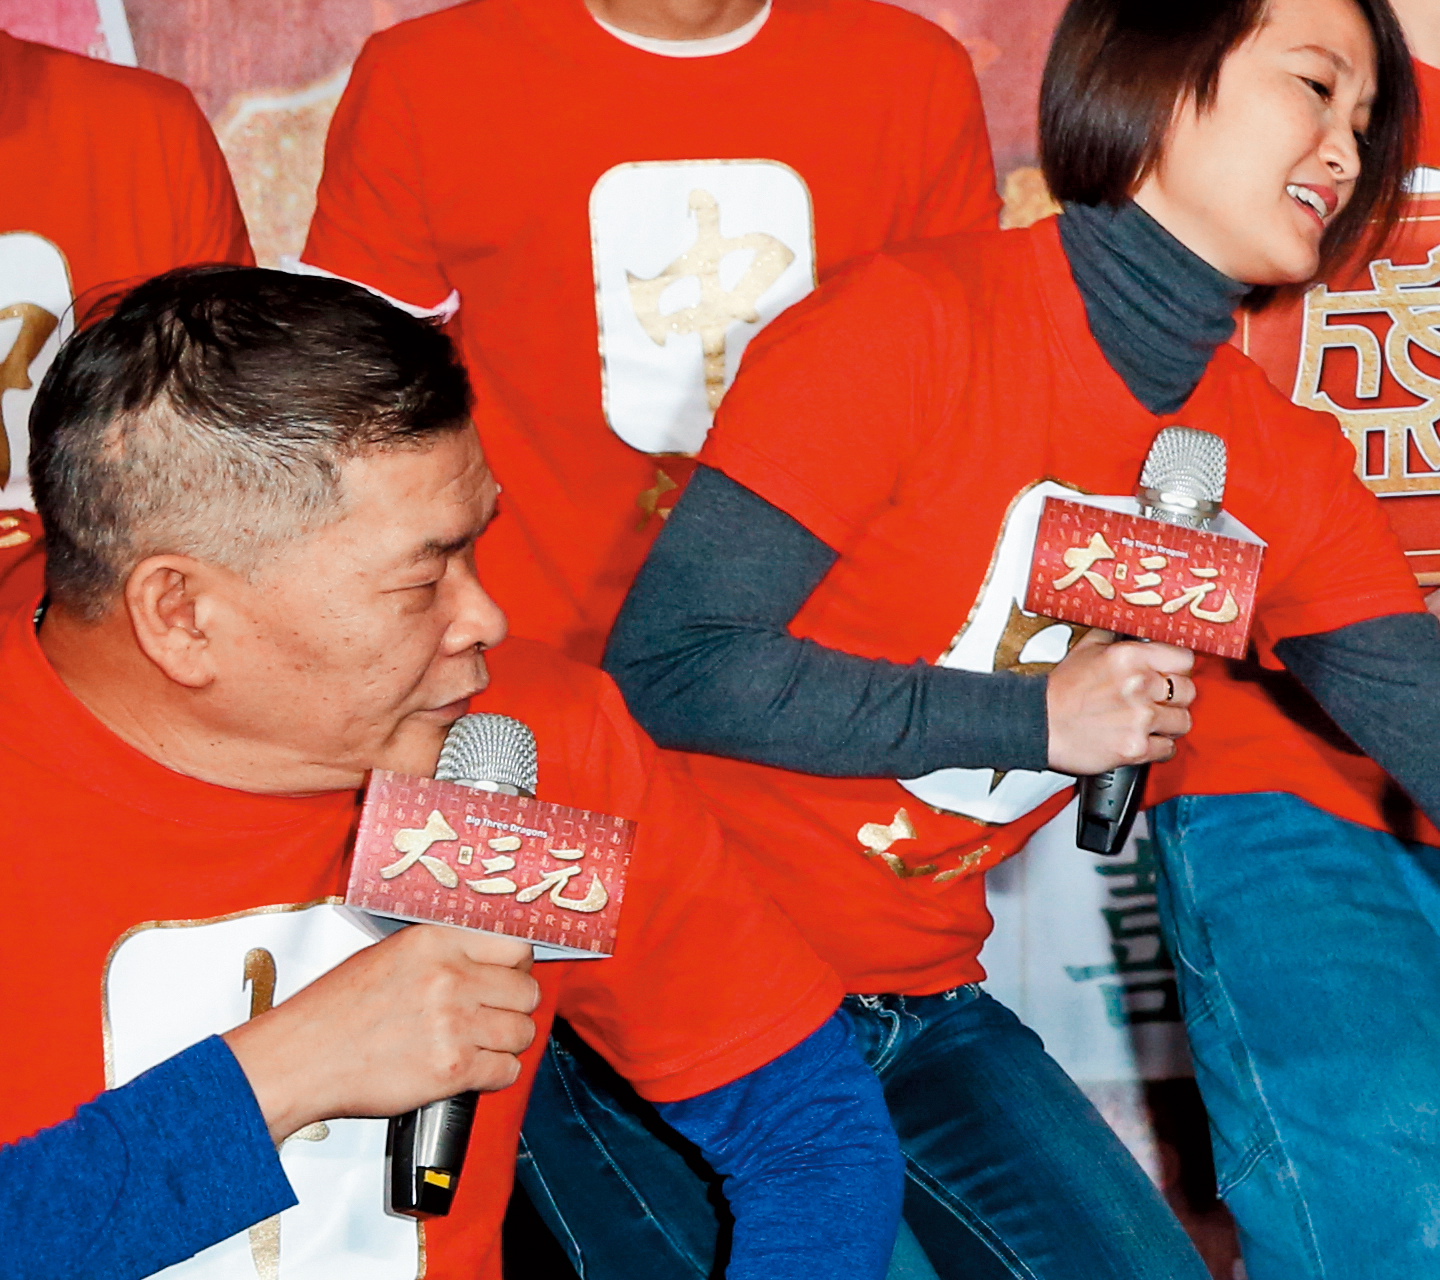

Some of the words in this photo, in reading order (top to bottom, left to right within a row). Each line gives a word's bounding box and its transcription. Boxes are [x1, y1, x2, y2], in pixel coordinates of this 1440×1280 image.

[1052, 531, 1240, 623] 大三元
[379, 808, 609, 913] 大三元
[465, 814, 481, 827] Big
[482, 817, 510, 831] Three
[509, 822, 549, 839] Dragons
